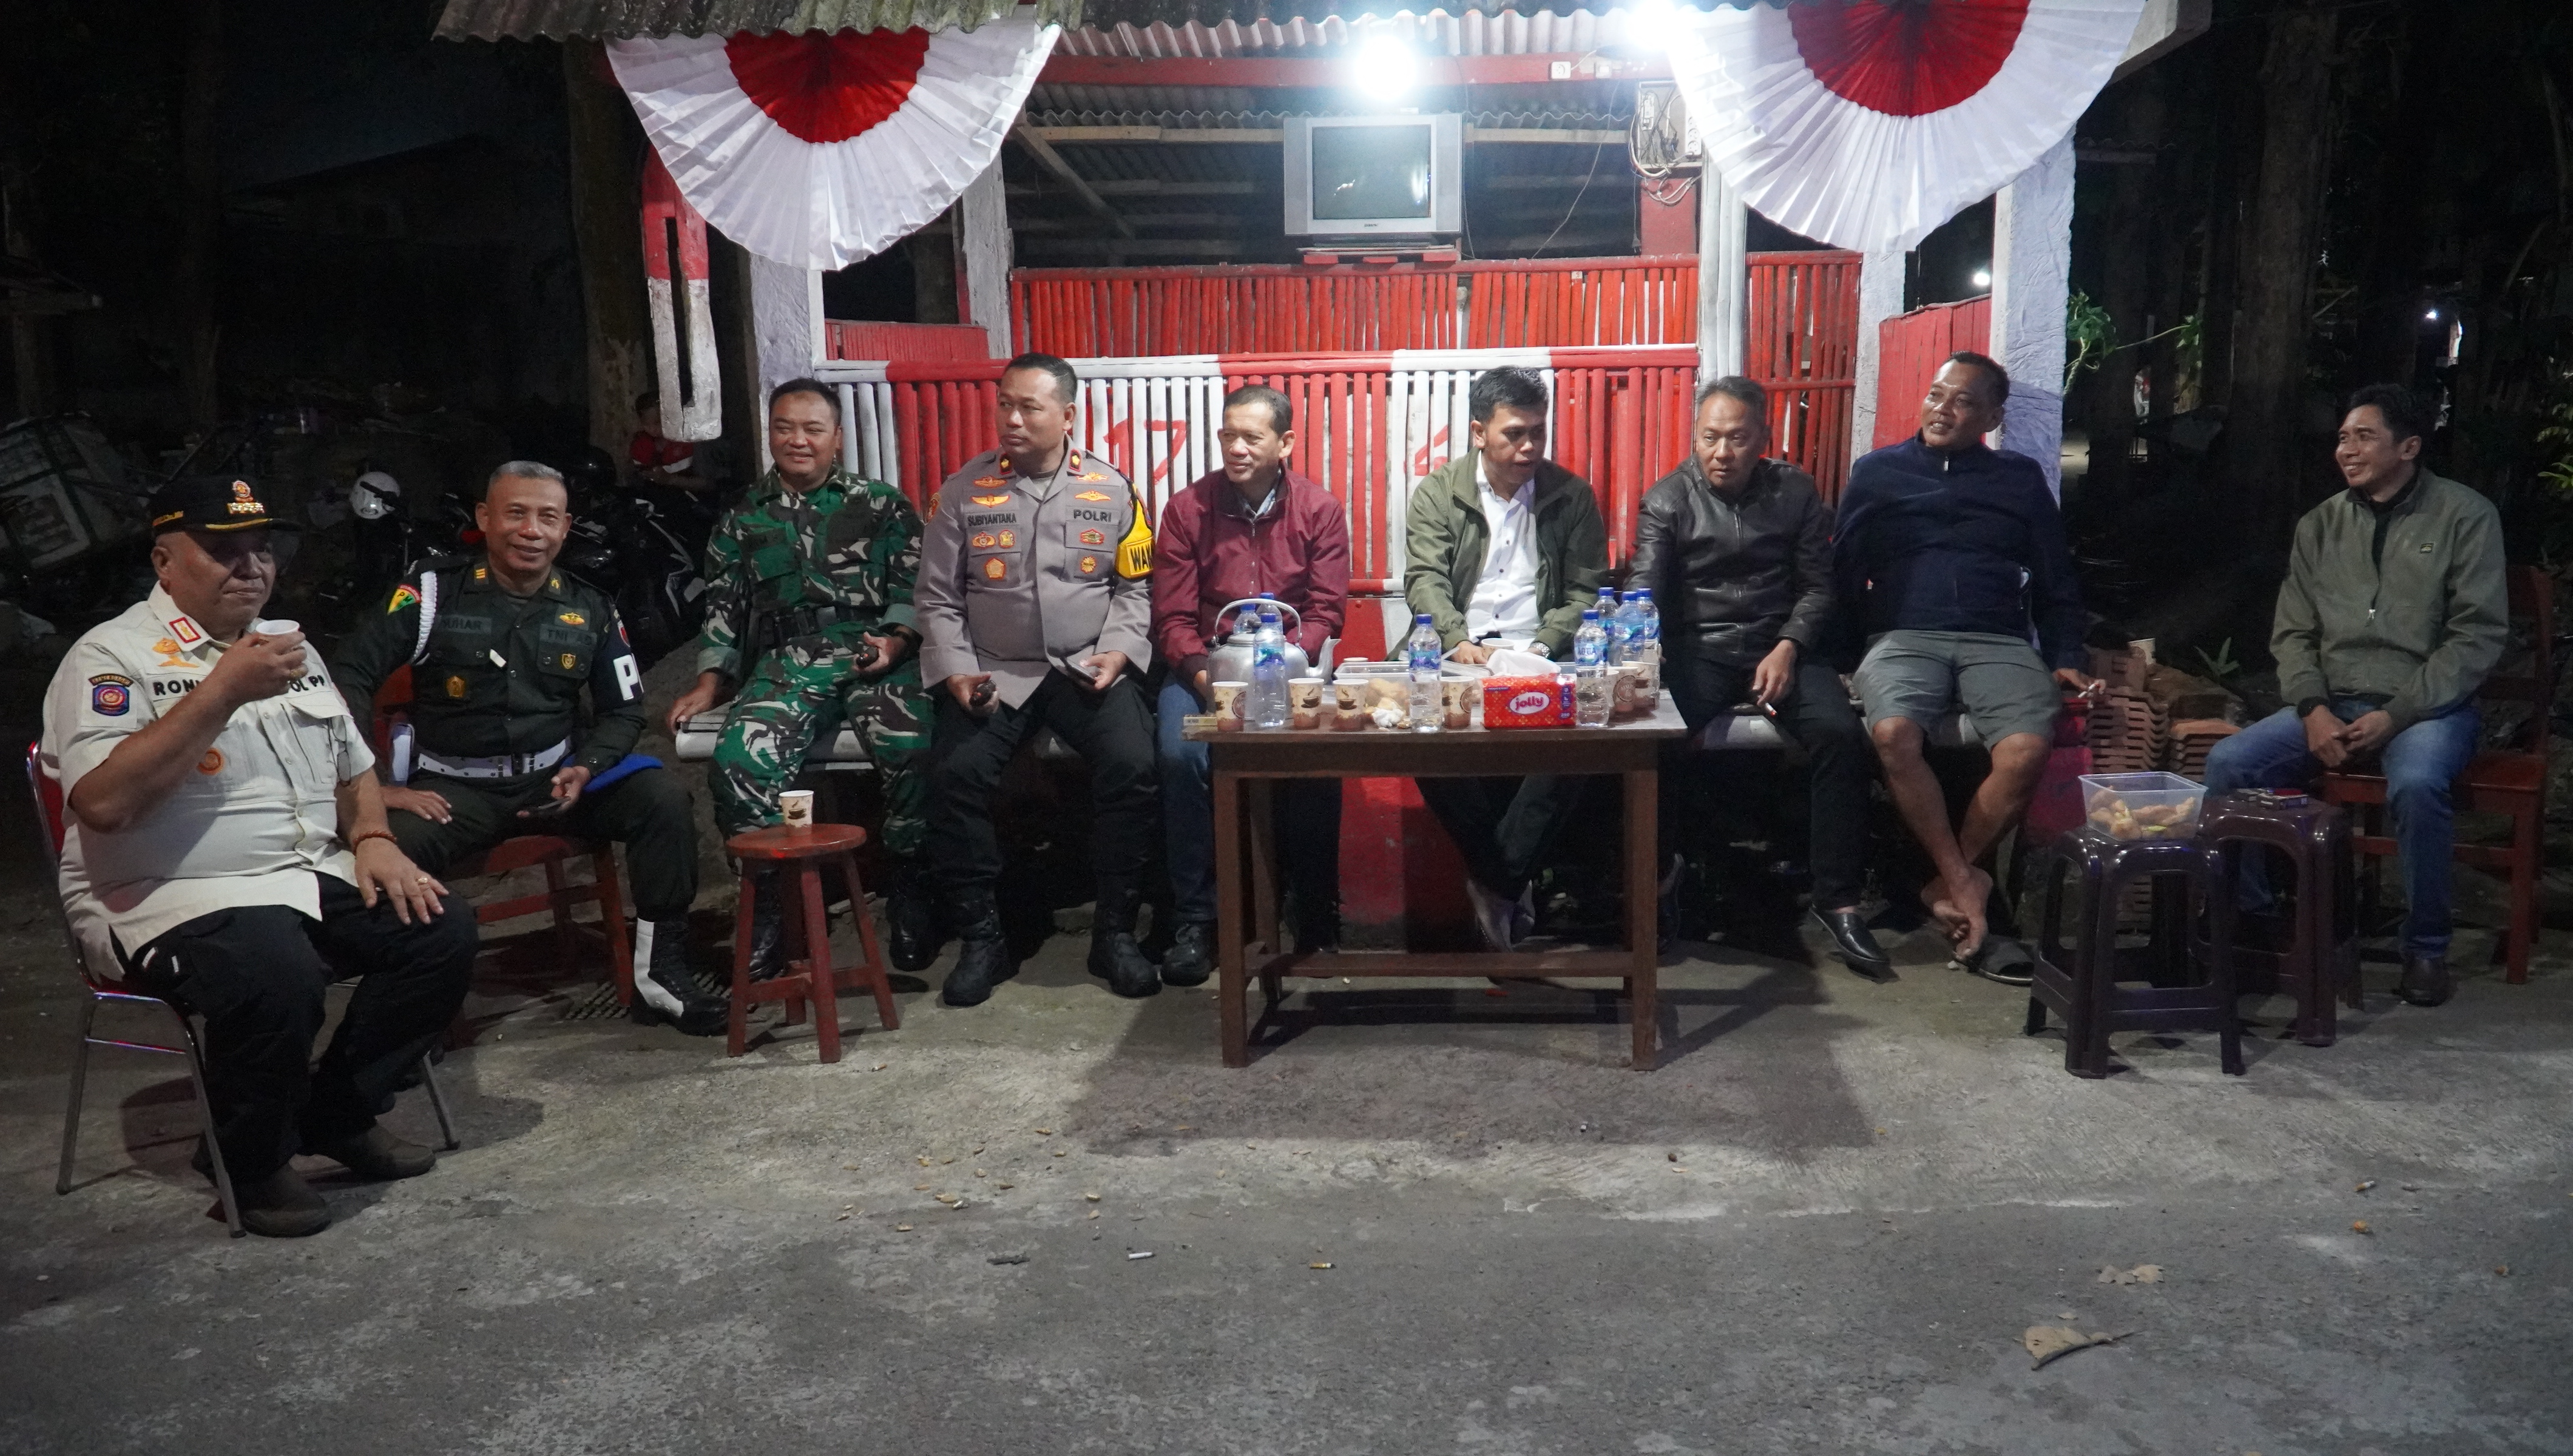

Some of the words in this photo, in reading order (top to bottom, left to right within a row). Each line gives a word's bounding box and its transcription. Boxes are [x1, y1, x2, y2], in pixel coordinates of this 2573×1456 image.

[1103, 418, 1186, 485] 17
[1073, 509, 1112, 522] POLRI
[1130, 543, 1153, 571] WAK
[153, 679, 200, 696] RON
[613, 653, 644, 700] P
[1515, 696, 1544, 711] jolly
